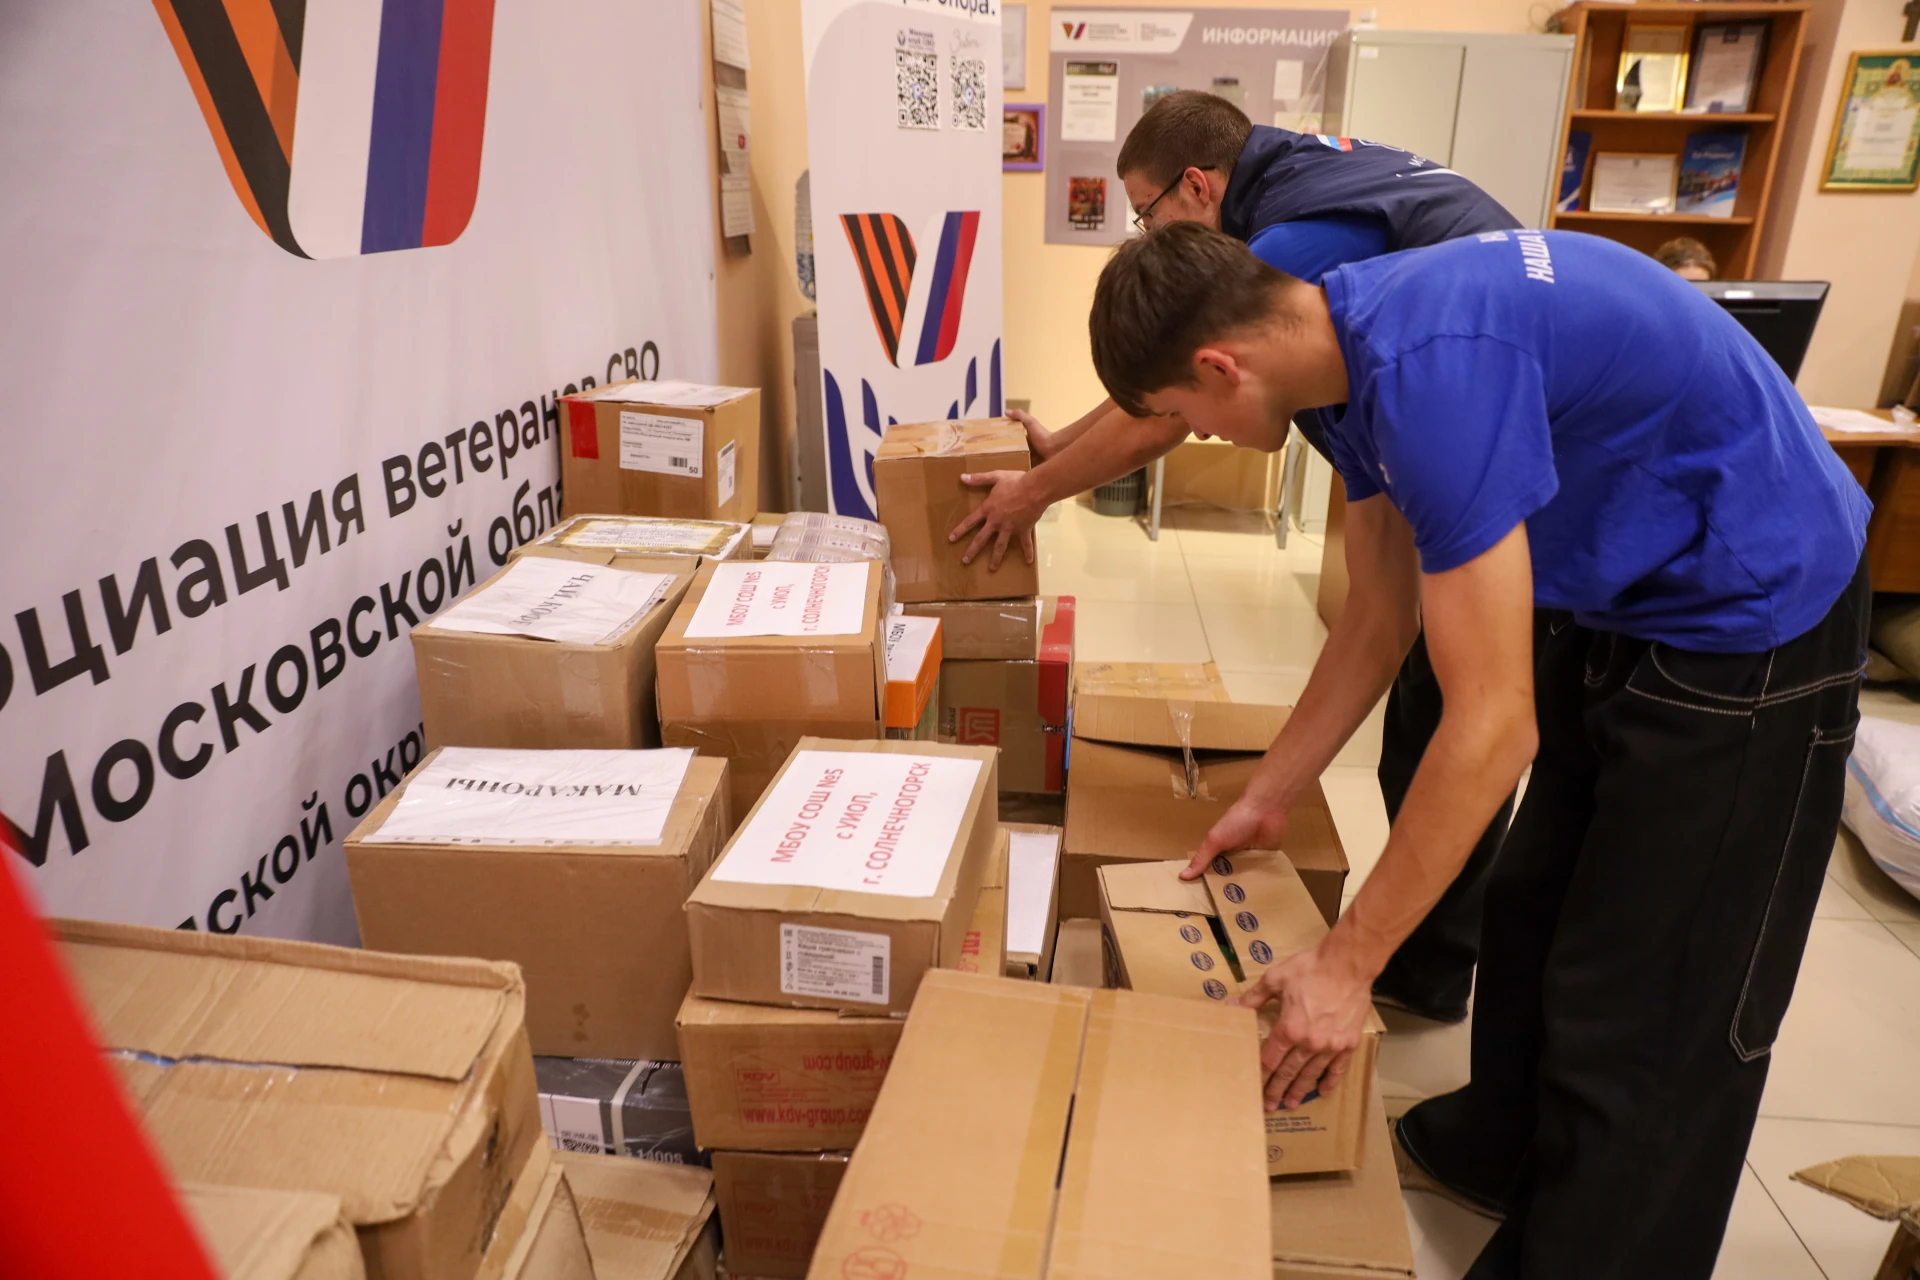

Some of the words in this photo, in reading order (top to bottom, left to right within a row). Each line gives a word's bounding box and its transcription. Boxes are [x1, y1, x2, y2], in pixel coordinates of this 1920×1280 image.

[1517, 235, 1555, 283] НАША
[381, 376, 596, 518] ветеран
[606, 340, 659, 384] СВО
[689, 466, 699, 474] 50
[736, 585, 757, 602] СОШ
[726, 603, 747, 626] МБОУ
[345, 722, 425, 818] окр
[445, 777, 642, 798] МАКАРОНЫ
[770, 822, 811, 863] МБОУ
[798, 790, 832, 820] СОШ
[816, 768, 844, 788] №5
[835, 792, 878, 830] УИОП,
[865, 762, 932, 870] СОЛНЕЧНОГОРСК
[836, 832, 853, 840] с
[863, 874, 884, 885] г.
